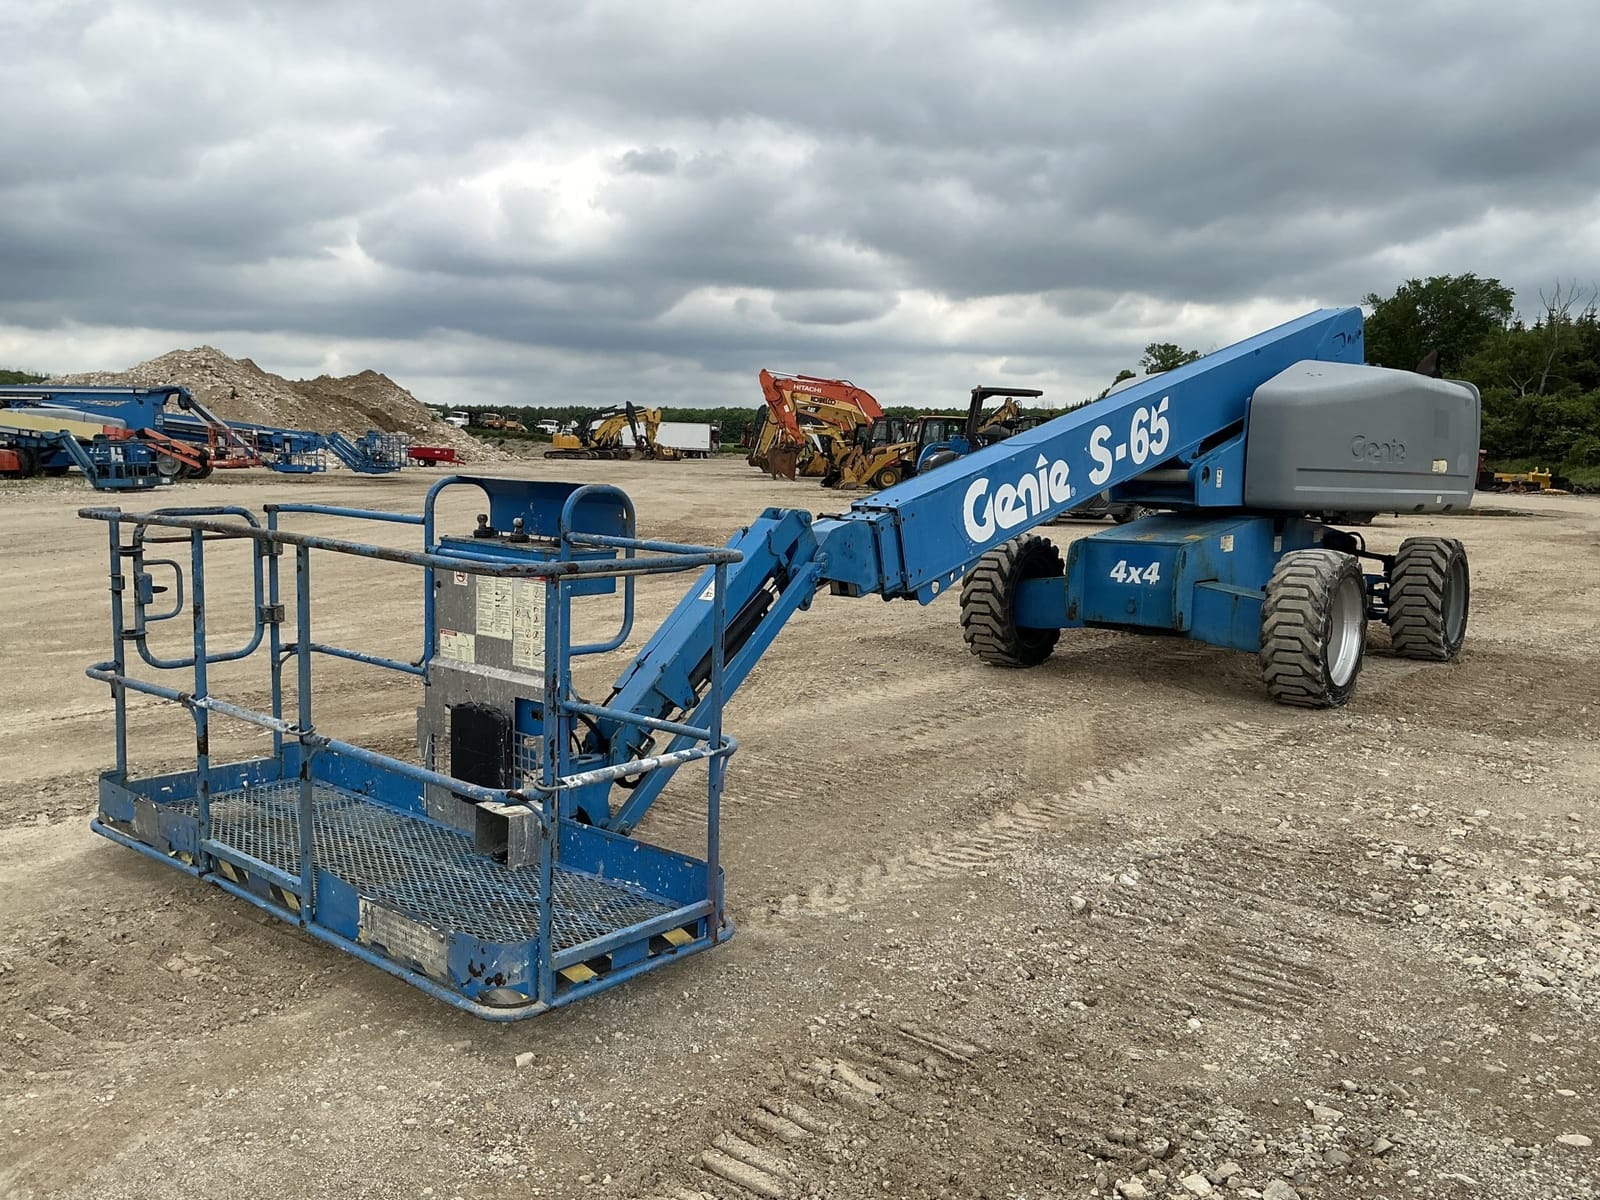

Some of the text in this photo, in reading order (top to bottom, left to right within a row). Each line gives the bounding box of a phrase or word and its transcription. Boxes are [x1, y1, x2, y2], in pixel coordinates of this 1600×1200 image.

[793, 383, 822, 393] HITACHI
[1351, 434, 1406, 464] Genie
[963, 396, 1170, 543] Genie S-65
[1109, 560, 1161, 585] 4x4
